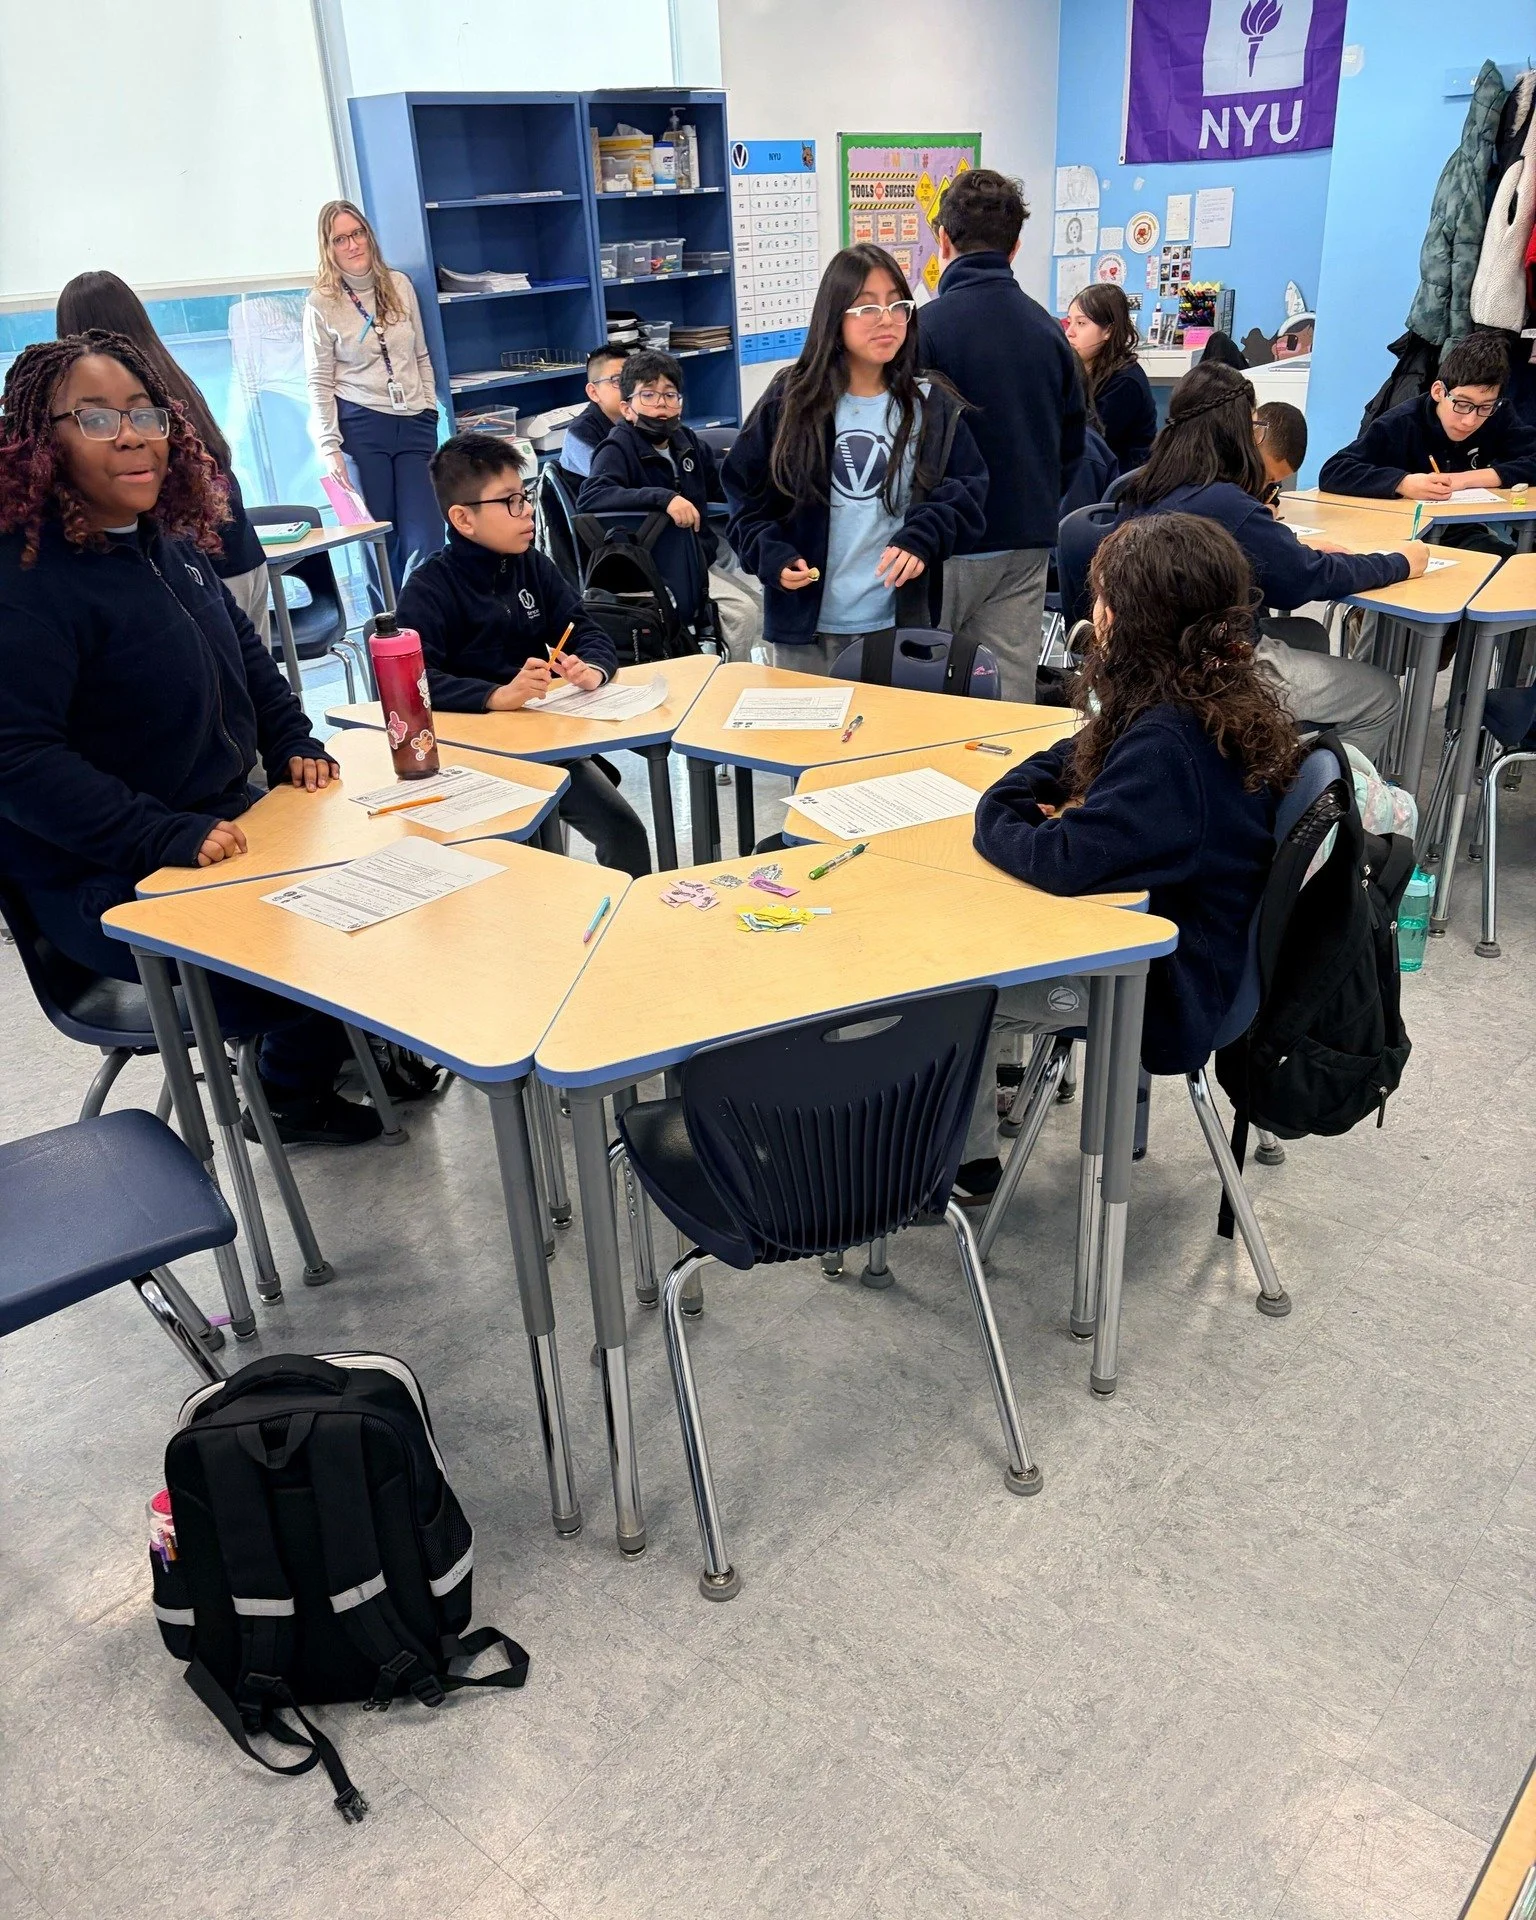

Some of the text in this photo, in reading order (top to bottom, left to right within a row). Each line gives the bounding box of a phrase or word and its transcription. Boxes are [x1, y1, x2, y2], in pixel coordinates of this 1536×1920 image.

[1198, 99, 1304, 150] NYU
[768, 152, 782, 160] NYU
[851, 184, 874, 197] TOOLS
[885, 184, 915, 197] SUCCESS
